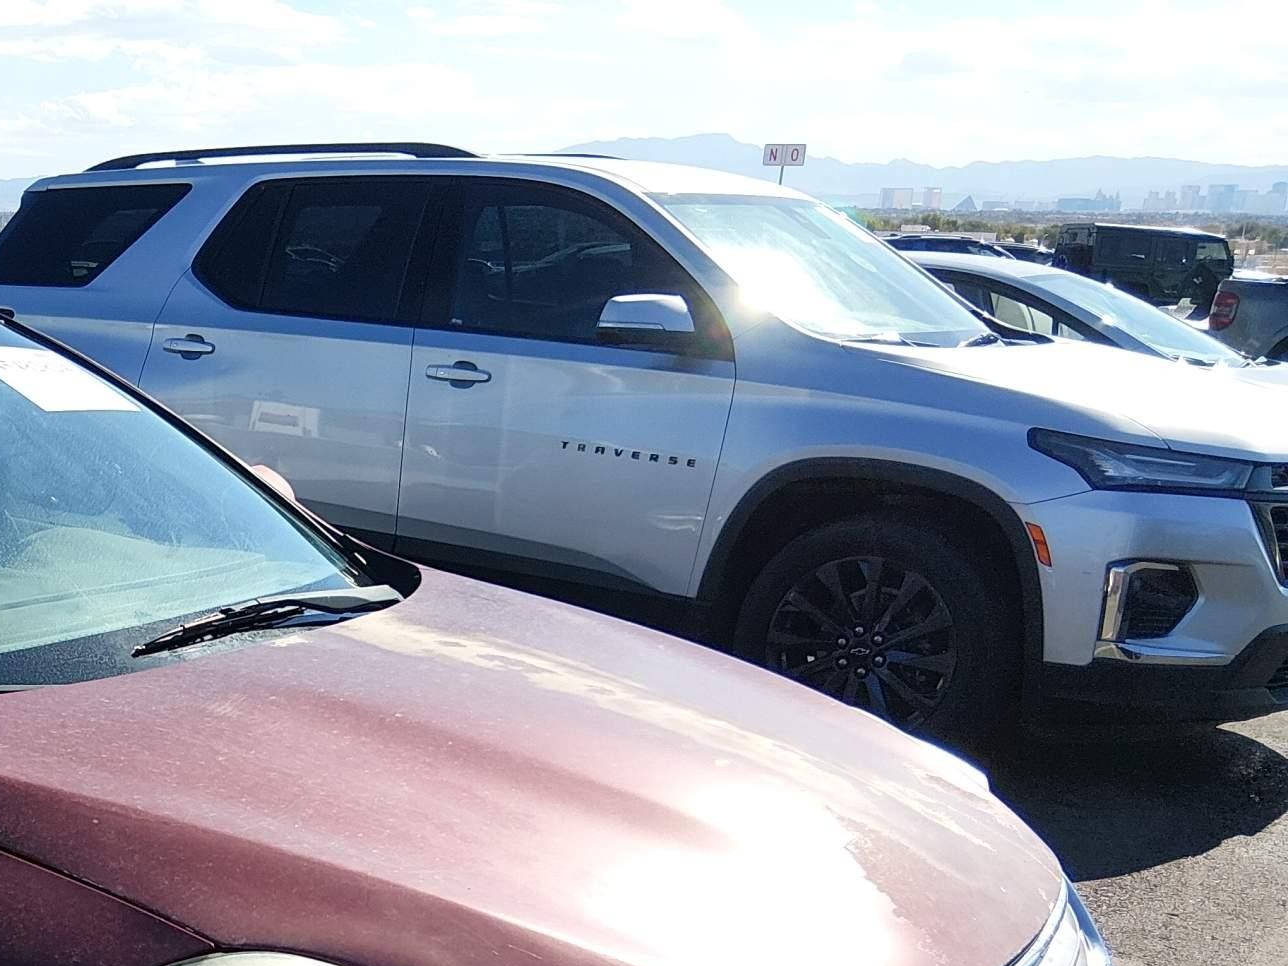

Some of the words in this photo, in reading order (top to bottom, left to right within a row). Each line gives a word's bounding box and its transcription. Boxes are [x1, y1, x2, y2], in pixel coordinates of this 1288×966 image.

[769, 148, 778, 161] N
[791, 148, 800, 161] O
[561, 441, 696, 468] TRAVERSE
